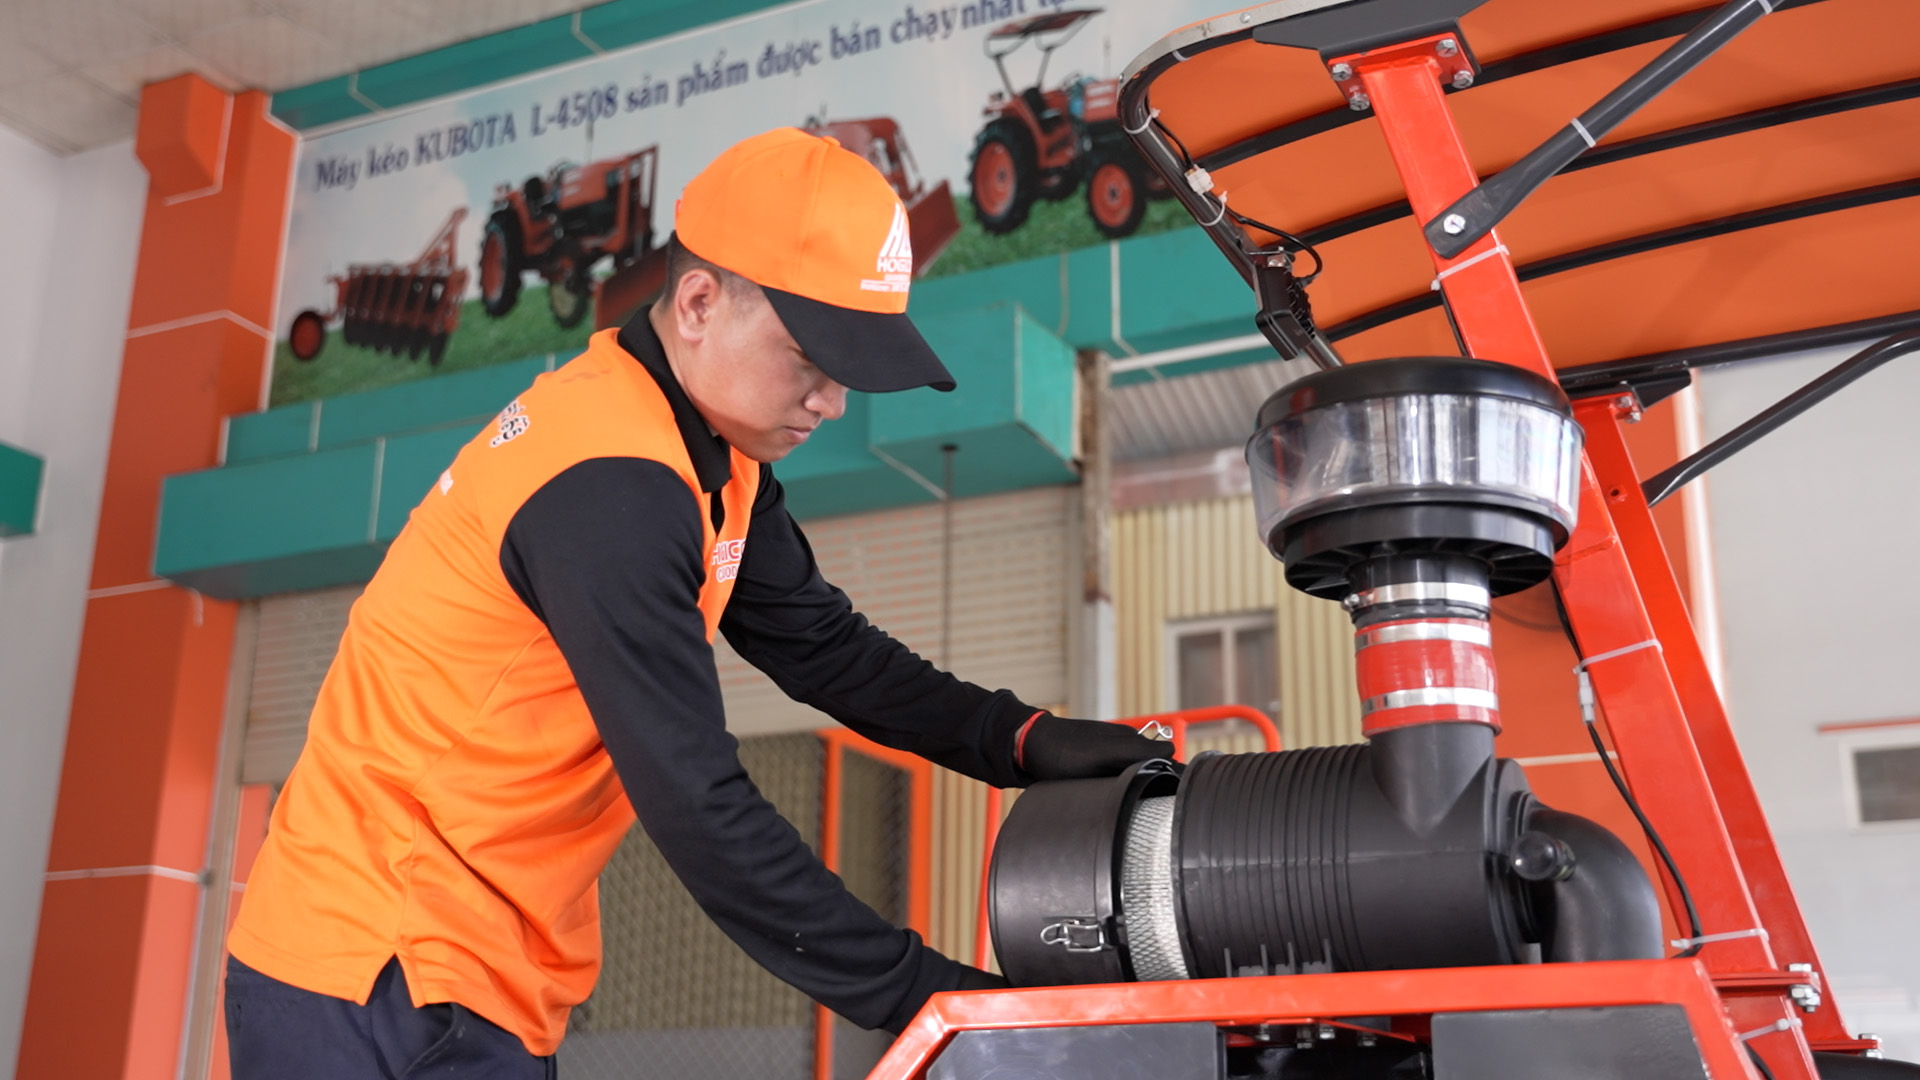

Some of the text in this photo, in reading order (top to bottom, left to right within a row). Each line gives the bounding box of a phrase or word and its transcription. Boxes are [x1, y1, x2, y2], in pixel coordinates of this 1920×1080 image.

[367, 143, 410, 178] kéo
[414, 112, 517, 167] KUBOTA
[530, 83, 619, 137] L-4508
[830, 19, 882, 60] bán
